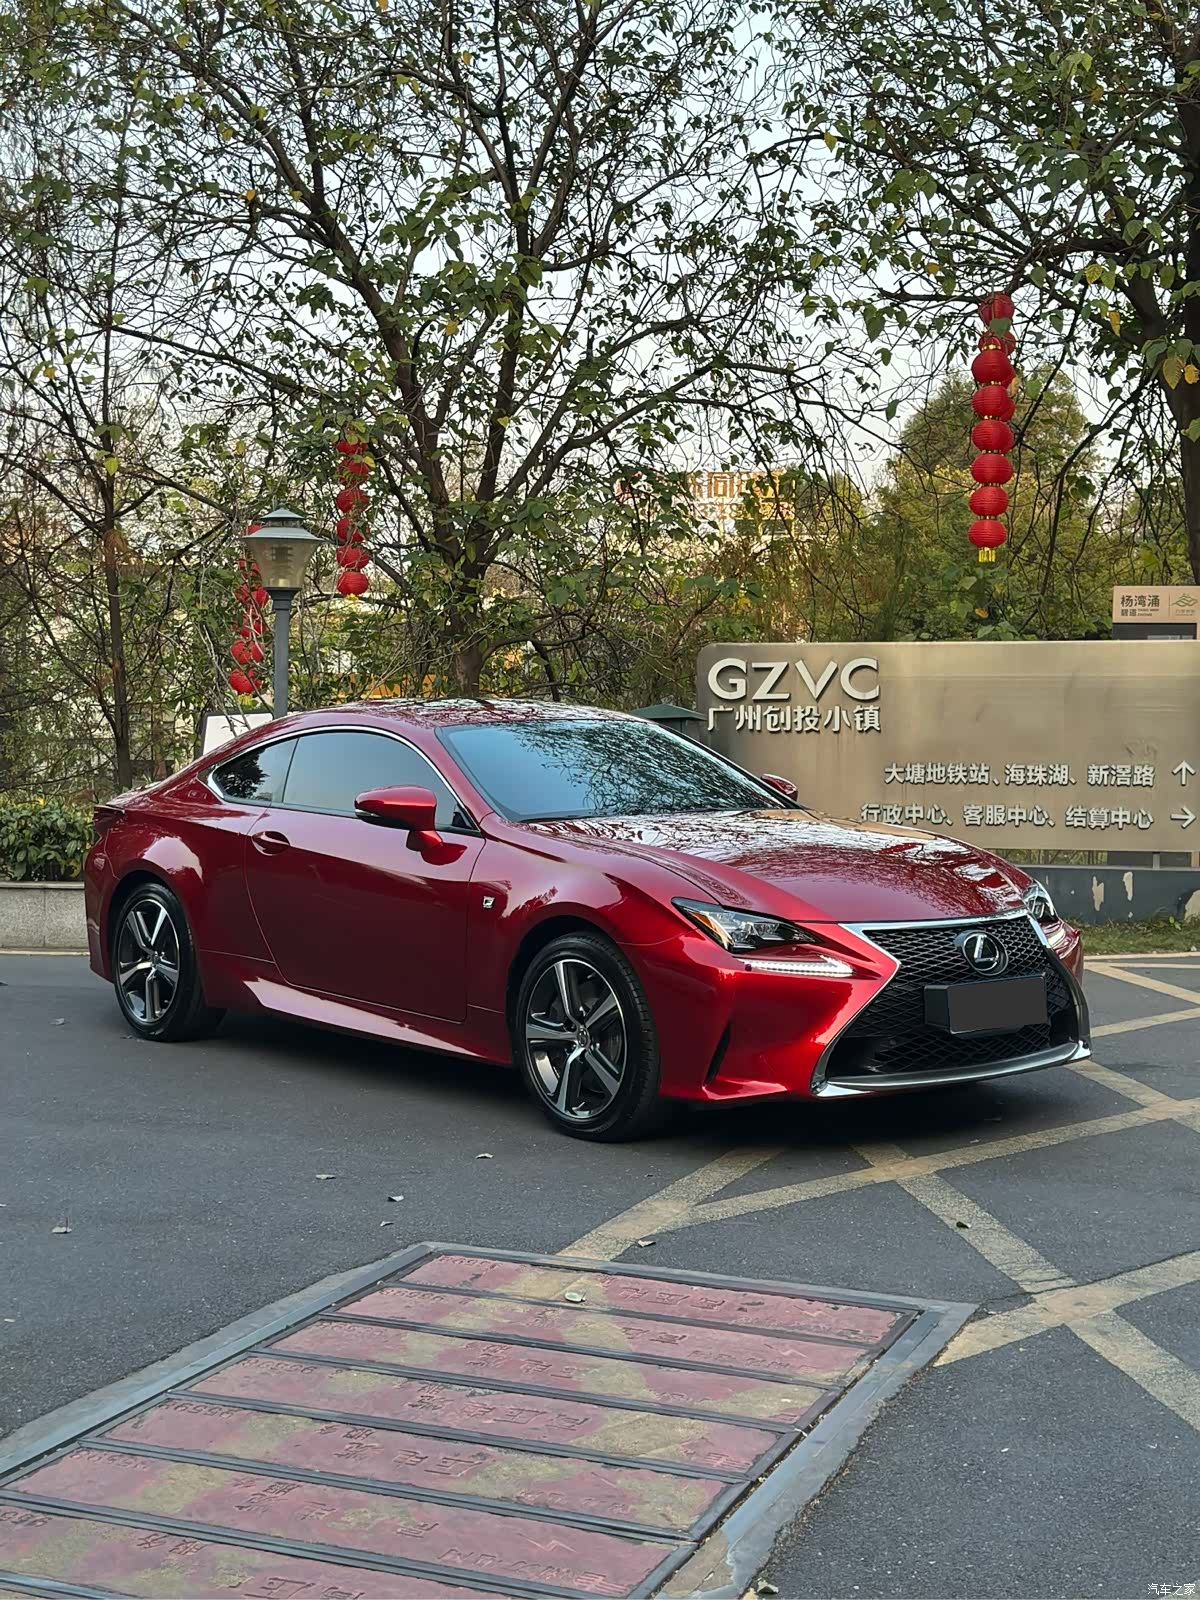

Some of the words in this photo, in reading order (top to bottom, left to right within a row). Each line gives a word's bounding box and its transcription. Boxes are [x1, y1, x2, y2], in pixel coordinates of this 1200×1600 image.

[707, 657, 881, 701] GZVC
[707, 704, 881, 733] 广州创投小镇
